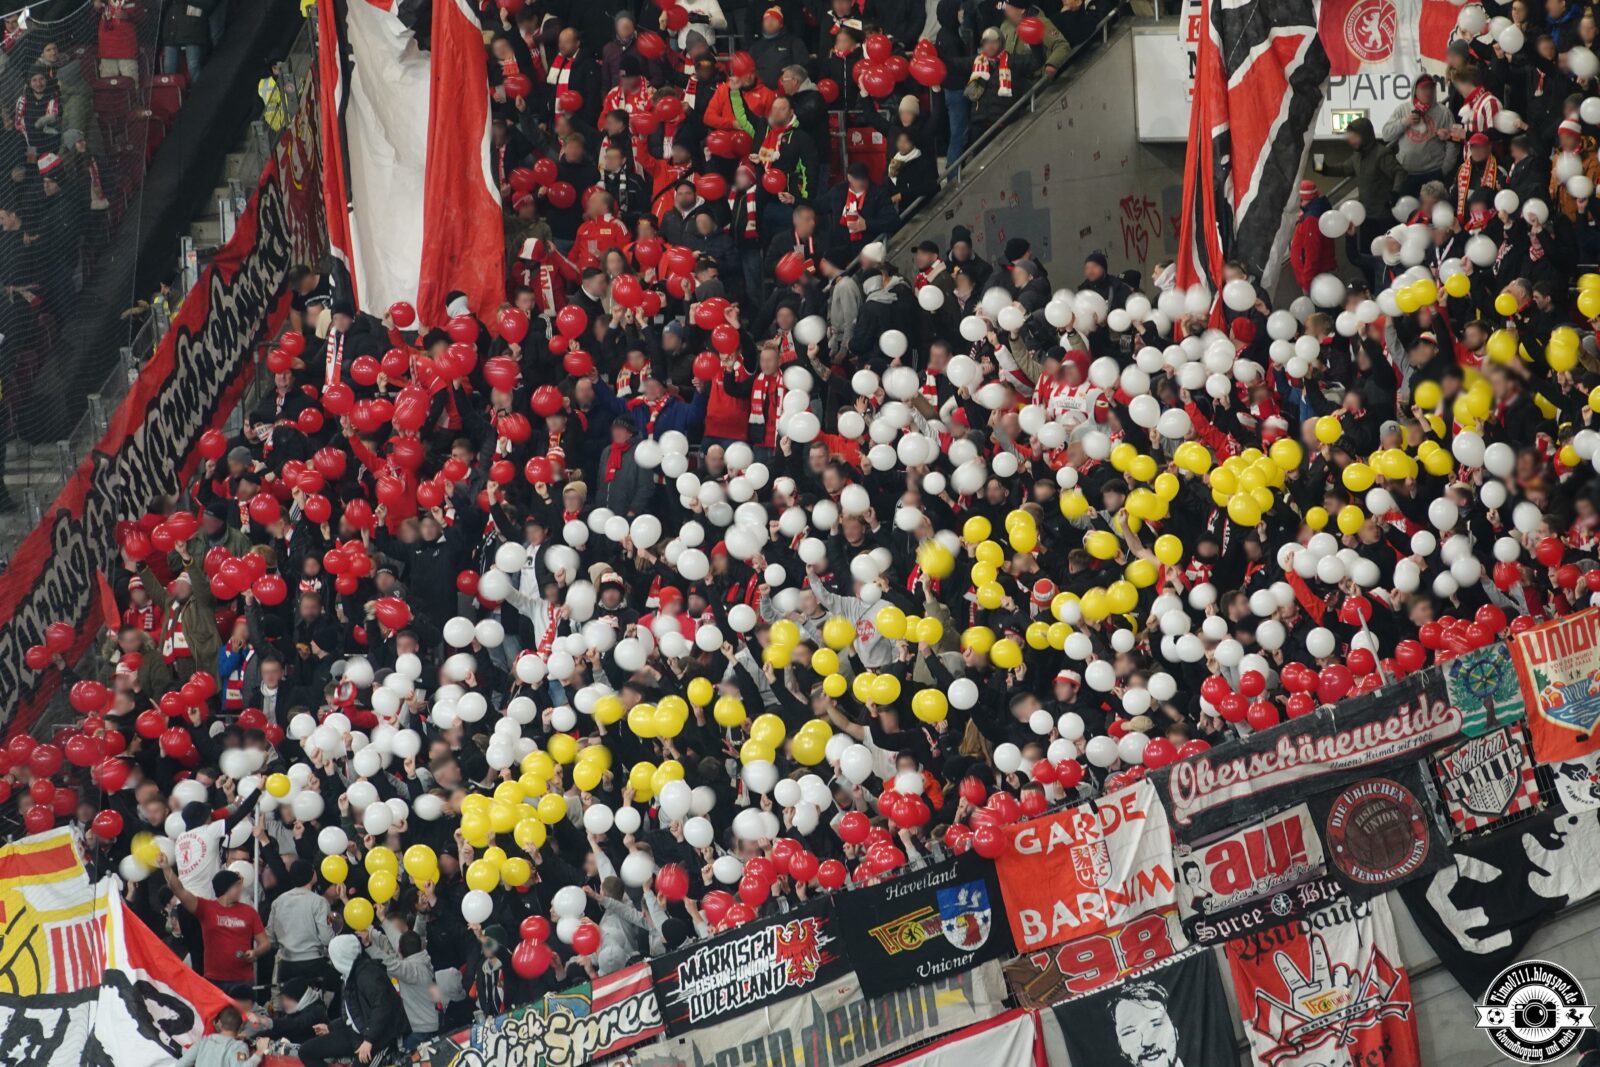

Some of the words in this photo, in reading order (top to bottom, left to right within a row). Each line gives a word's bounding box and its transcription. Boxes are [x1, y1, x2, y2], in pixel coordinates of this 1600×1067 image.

[1169, 694, 1449, 809] Oberschöneweide
[1445, 743, 1523, 801] PLATTE
[1451, 733, 1503, 778] Sektion
[1014, 791, 1147, 855] GARDE
[1331, 803, 1348, 828] DIE
[1343, 782, 1406, 804] ÜBLICHEN
[1354, 799, 1387, 826] EISERN
[1363, 809, 1401, 834] UNION
[885, 861, 958, 901] Havelland
[1351, 838, 1425, 881] VERDÄCHTIGEN
[1019, 864, 1175, 945] BARNIM
[1195, 907, 1265, 943] Spree
[678, 926, 778, 991] MÄRKISCH
[916, 952, 975, 978] Unioner
[688, 960, 788, 1024] ODERLAND
[504, 1011, 543, 1044] Sek
[545, 992, 662, 1067] Spree
